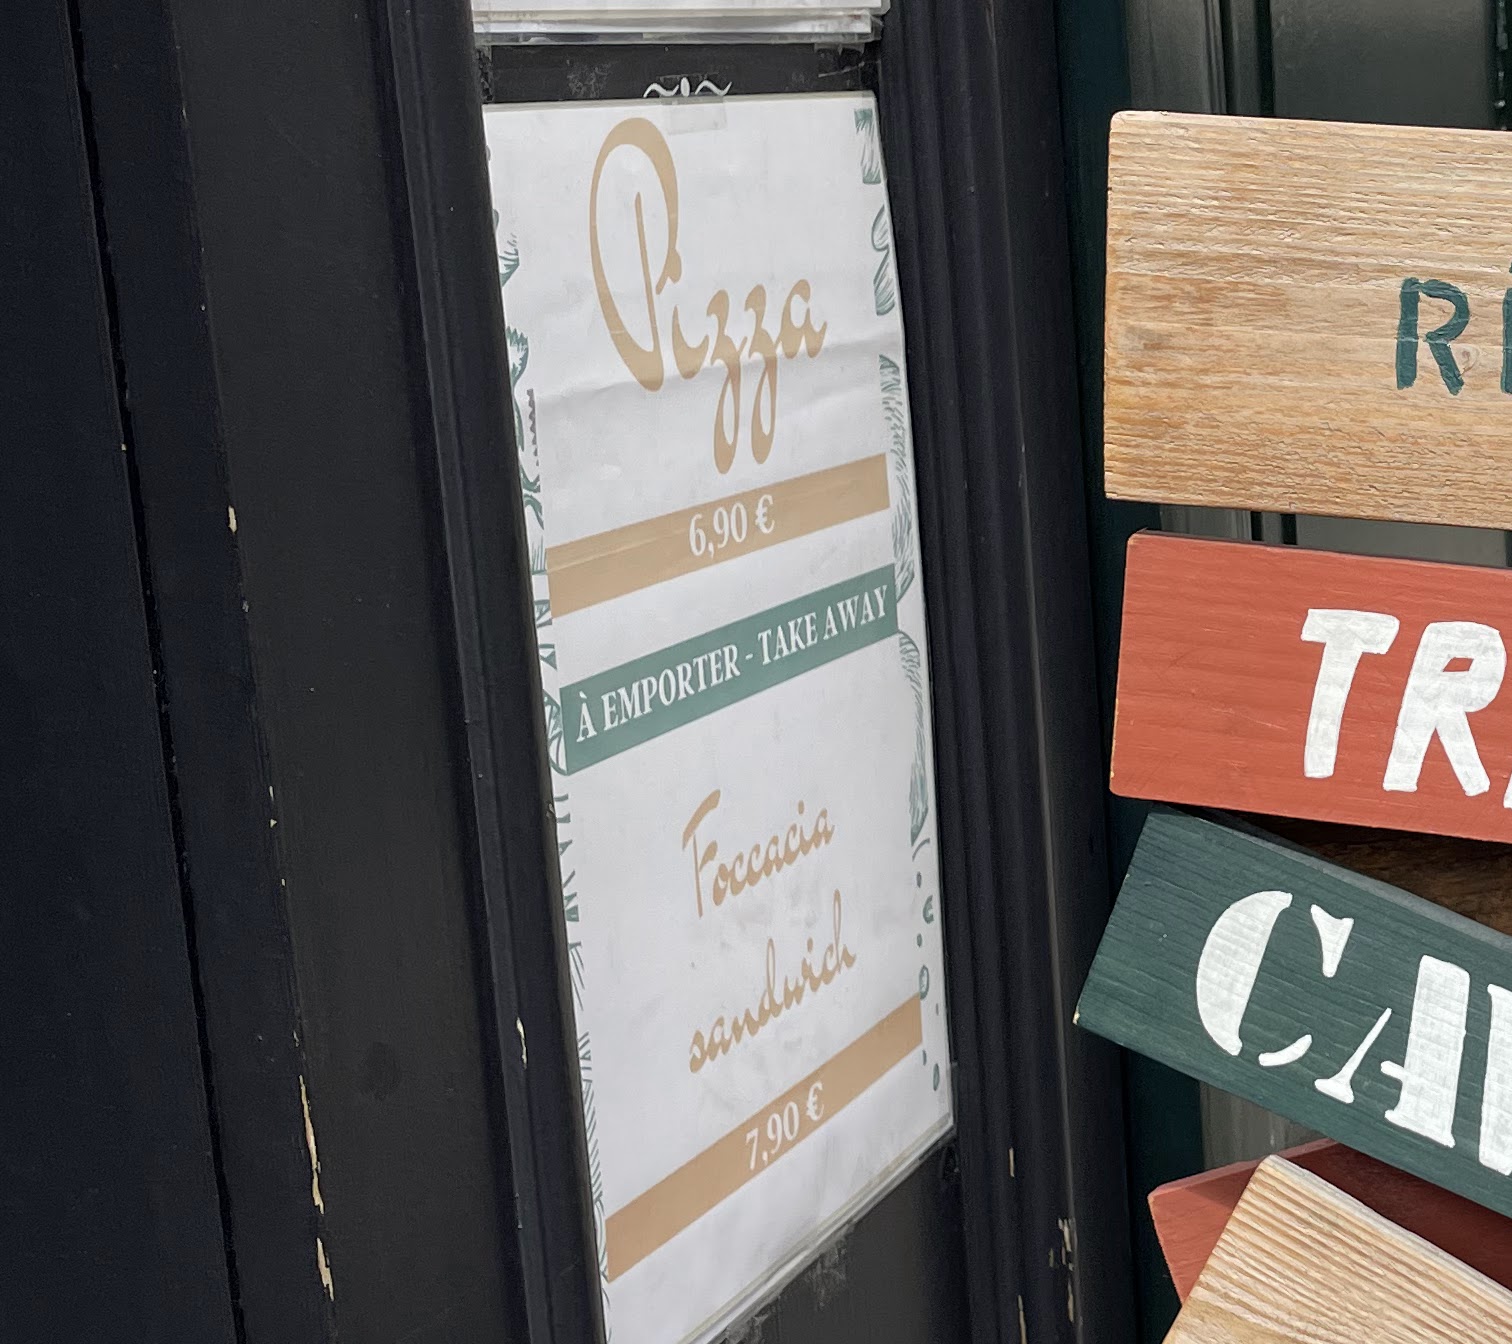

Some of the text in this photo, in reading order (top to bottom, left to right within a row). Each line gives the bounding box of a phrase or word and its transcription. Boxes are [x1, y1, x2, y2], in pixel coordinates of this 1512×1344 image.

[589, 117, 827, 475] Pizza
[576, 691, 597, 743] À
[601, 644, 741, 732] EMPORTER
[758, 612, 818, 666] TAKE
[823, 584, 888, 641] AWAY
[682, 789, 836, 919] Foccacia
[689, 888, 856, 1074] sandwich
